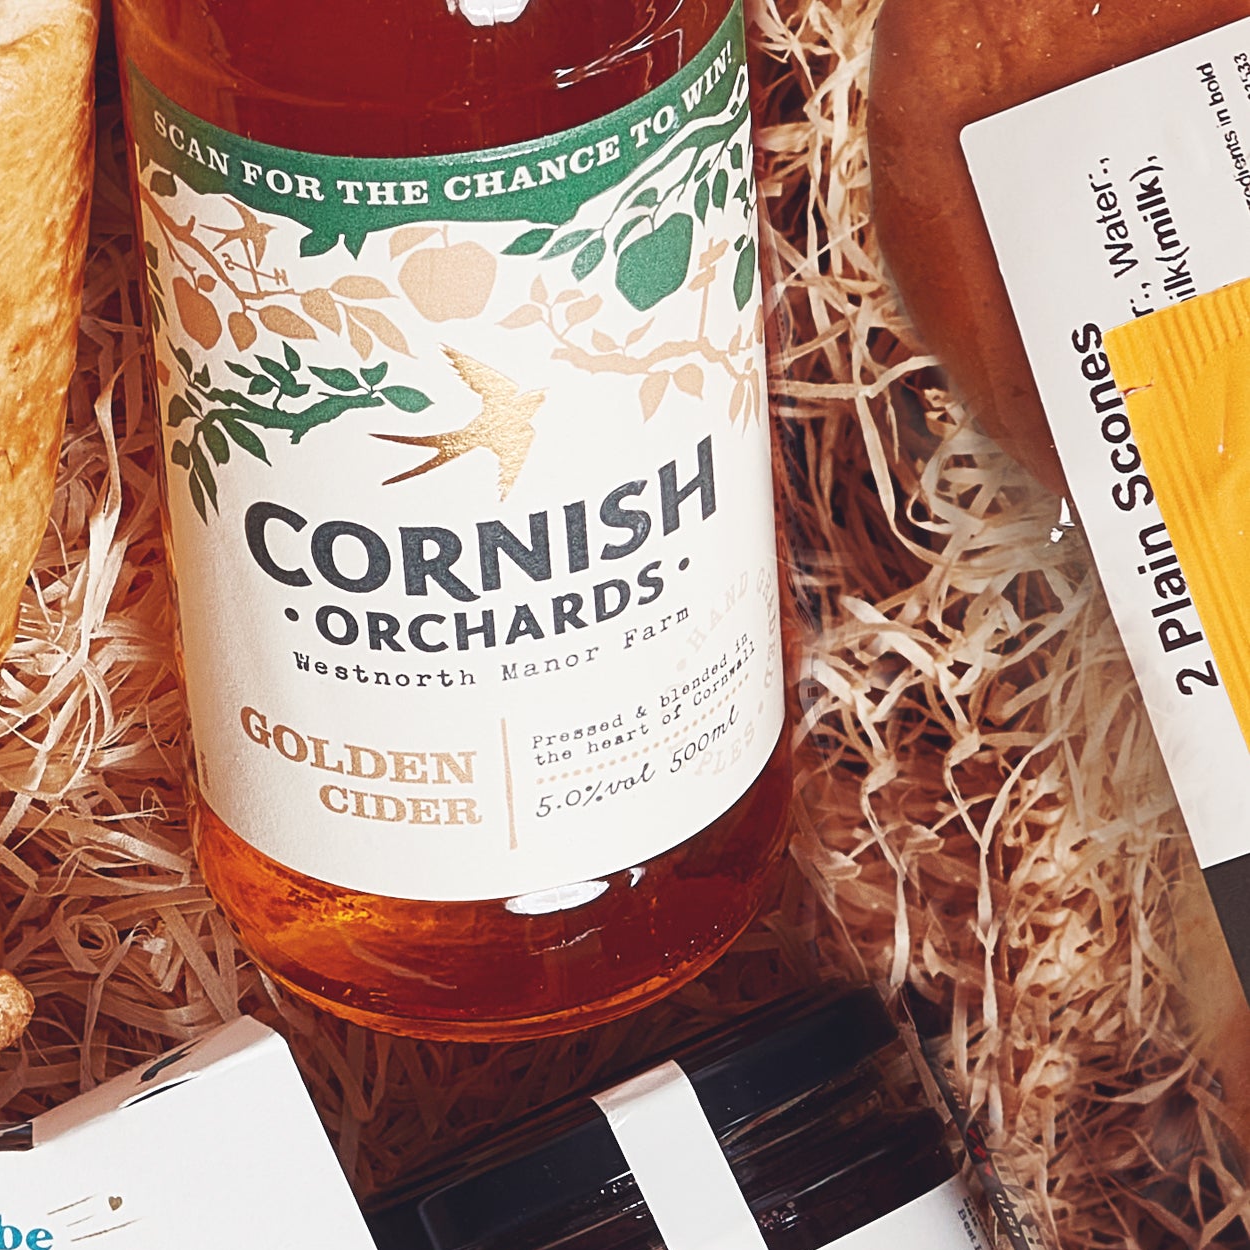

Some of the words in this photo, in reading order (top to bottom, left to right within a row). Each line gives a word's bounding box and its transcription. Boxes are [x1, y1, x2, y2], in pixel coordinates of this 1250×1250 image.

[153, 110, 229, 176] SCAN
[241, 160, 325, 202] FOR
[337, 180, 430, 207] THE
[443, 135, 620, 203] CHANCE
[629, 104, 676, 151] TO
[680, 40, 734, 112] WIN!
[1196, 62, 1225, 107] bold
[1216, 108, 1233, 128] in
[1129, 155, 1198, 303] ilk(milk),
[1071, 322, 1155, 512] Scones
[243, 434, 718, 602] CORNISH
[315, 560, 666, 654] ORCHARDS
[1139, 522, 1205, 652] Plain
[293, 651, 477, 688] Westnorth
[501, 645, 601, 682] Manor
[623, 605, 691, 649] Farm
[1176, 660, 1219, 696] 2
[532, 714, 623, 750] Pressed
[635, 705, 648, 719] &
[659, 653, 728, 709] blended
[735, 632, 748, 654] in
[534, 749, 572, 766] the
[587, 723, 649, 755] heart
[661, 704, 682, 725] of
[693, 640, 756, 707] Cornwall
[239, 705, 479, 785] GOLDEN
[670, 704, 740, 774] 500ml
[318, 784, 483, 827] CIDER
[957, 1206, 977, 1246] Best
